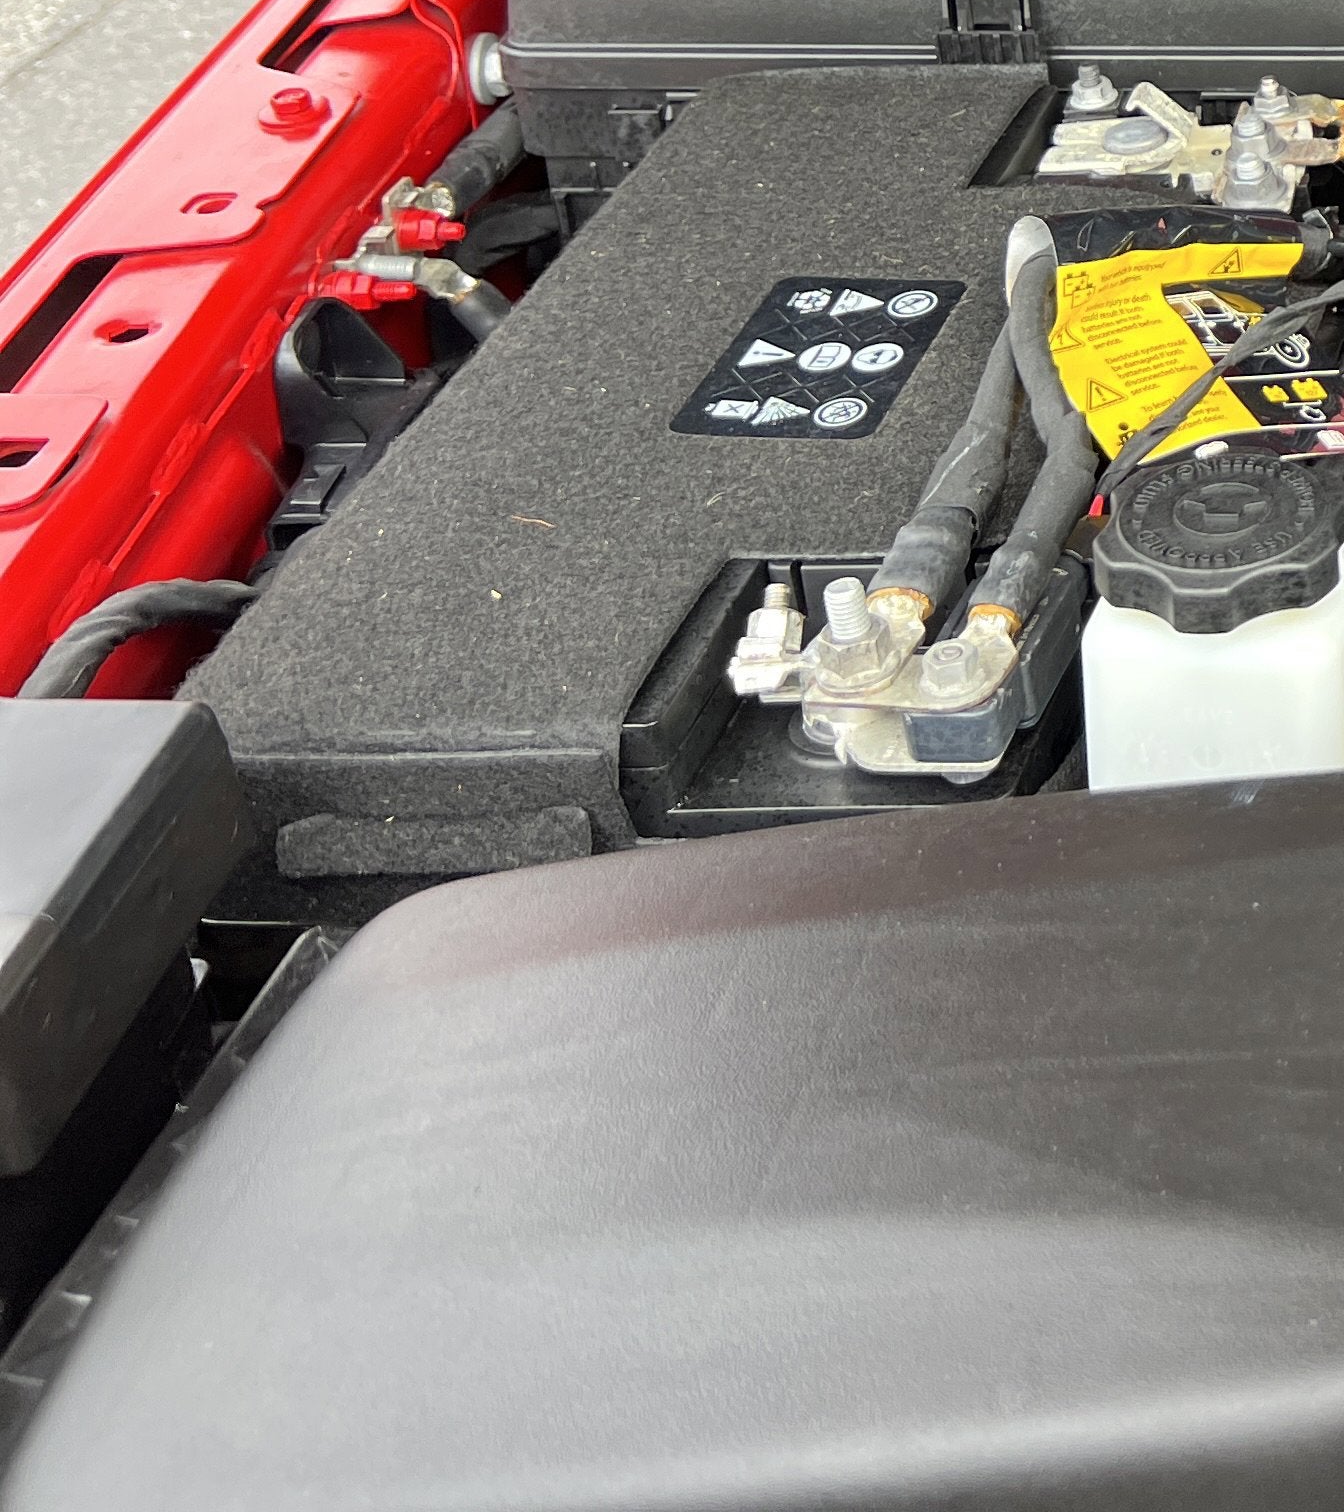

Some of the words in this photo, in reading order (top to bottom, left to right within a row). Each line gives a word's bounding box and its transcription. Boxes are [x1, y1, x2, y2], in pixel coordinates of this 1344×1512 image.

[1132, 473, 1175, 513] FLUID
[1137, 528, 1243, 565] APPROVED
[1252, 530, 1294, 555] USE
